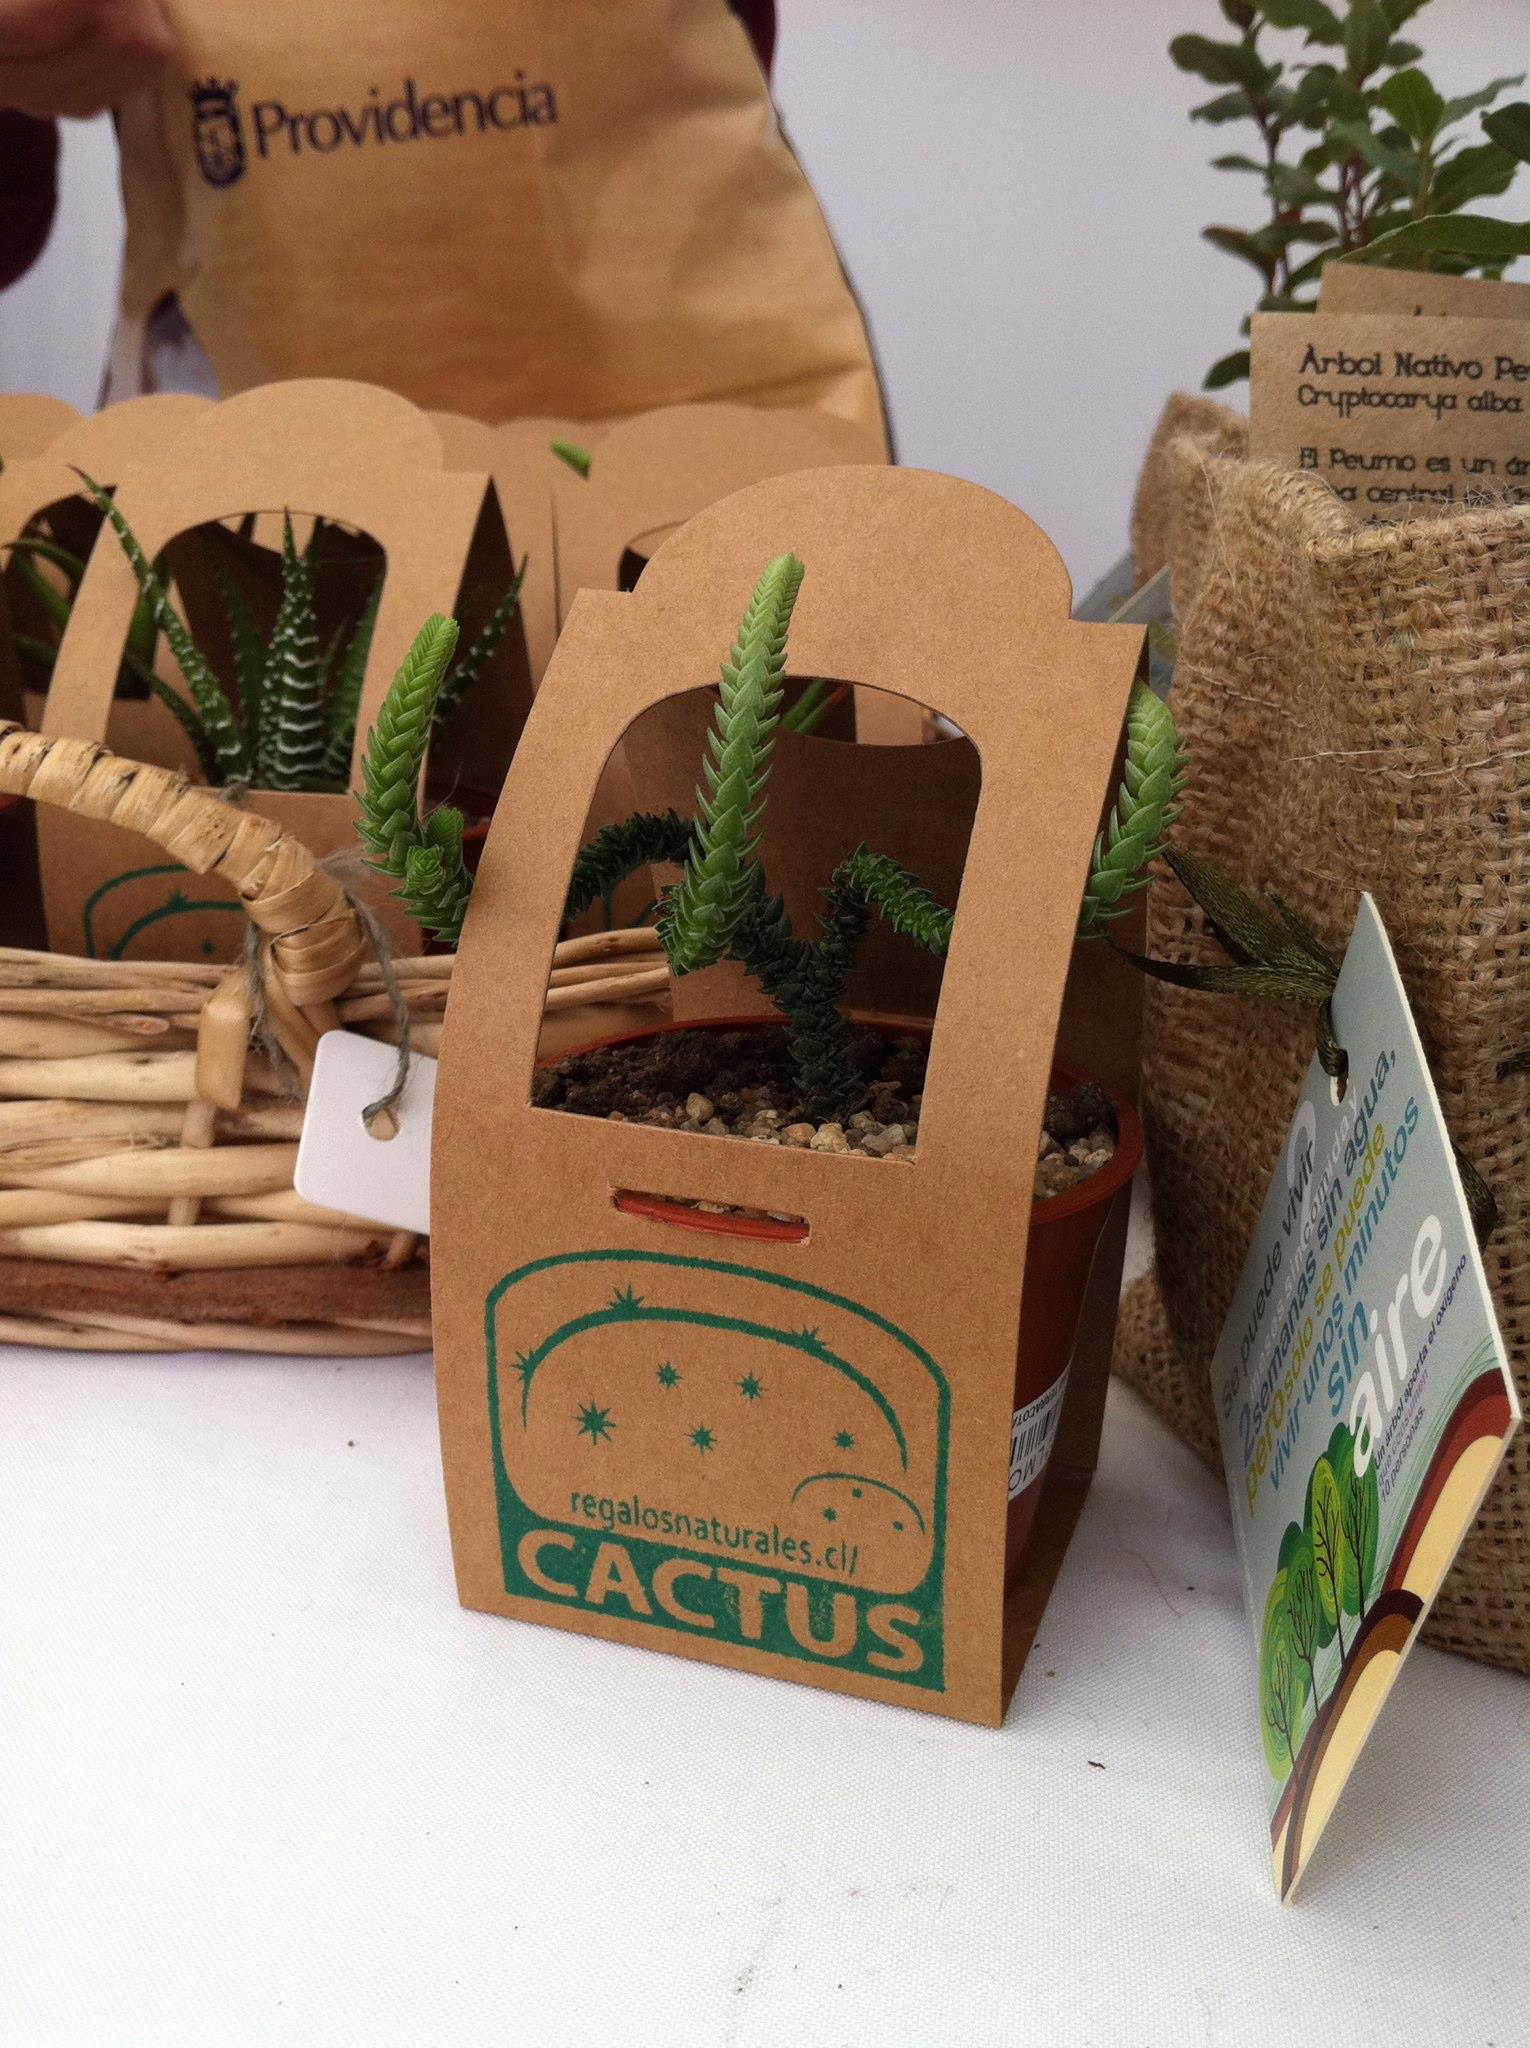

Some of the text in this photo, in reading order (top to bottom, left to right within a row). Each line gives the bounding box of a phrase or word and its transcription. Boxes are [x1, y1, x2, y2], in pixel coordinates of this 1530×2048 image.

[252, 69, 557, 158] Providencia
[1297, 384, 1524, 420] Cryptocarya alba
[1394, 352, 1483, 380] Nativo
[1495, 355, 1530, 383] Pe
[1299, 447, 1319, 469] El
[1329, 448, 1416, 472] Peumo
[1426, 455, 1451, 473] es
[1462, 457, 1496, 475] un
[1366, 483, 1454, 503] central
[1253, 1250, 1316, 1435] semanas
[1317, 1177, 1343, 1250] sin
[1343, 1049, 1396, 1176] agua,
[1303, 1115, 1349, 1245] comida
[1314, 1262, 1333, 1318] se
[1333, 1122, 1384, 1272] puede
[1223, 1140, 1313, 1419] Se puede vivir
[1270, 1096, 1419, 1490] vivir unos minutos
[1350, 1214, 1447, 1477] aire
[1328, 1301, 1369, 1417] sin
[1375, 1438, 1386, 1470] Un
[1403, 1343, 1429, 1402] aporta
[1427, 1321, 1437, 1345] el
[516, 1528, 924, 1672] CACTUS
